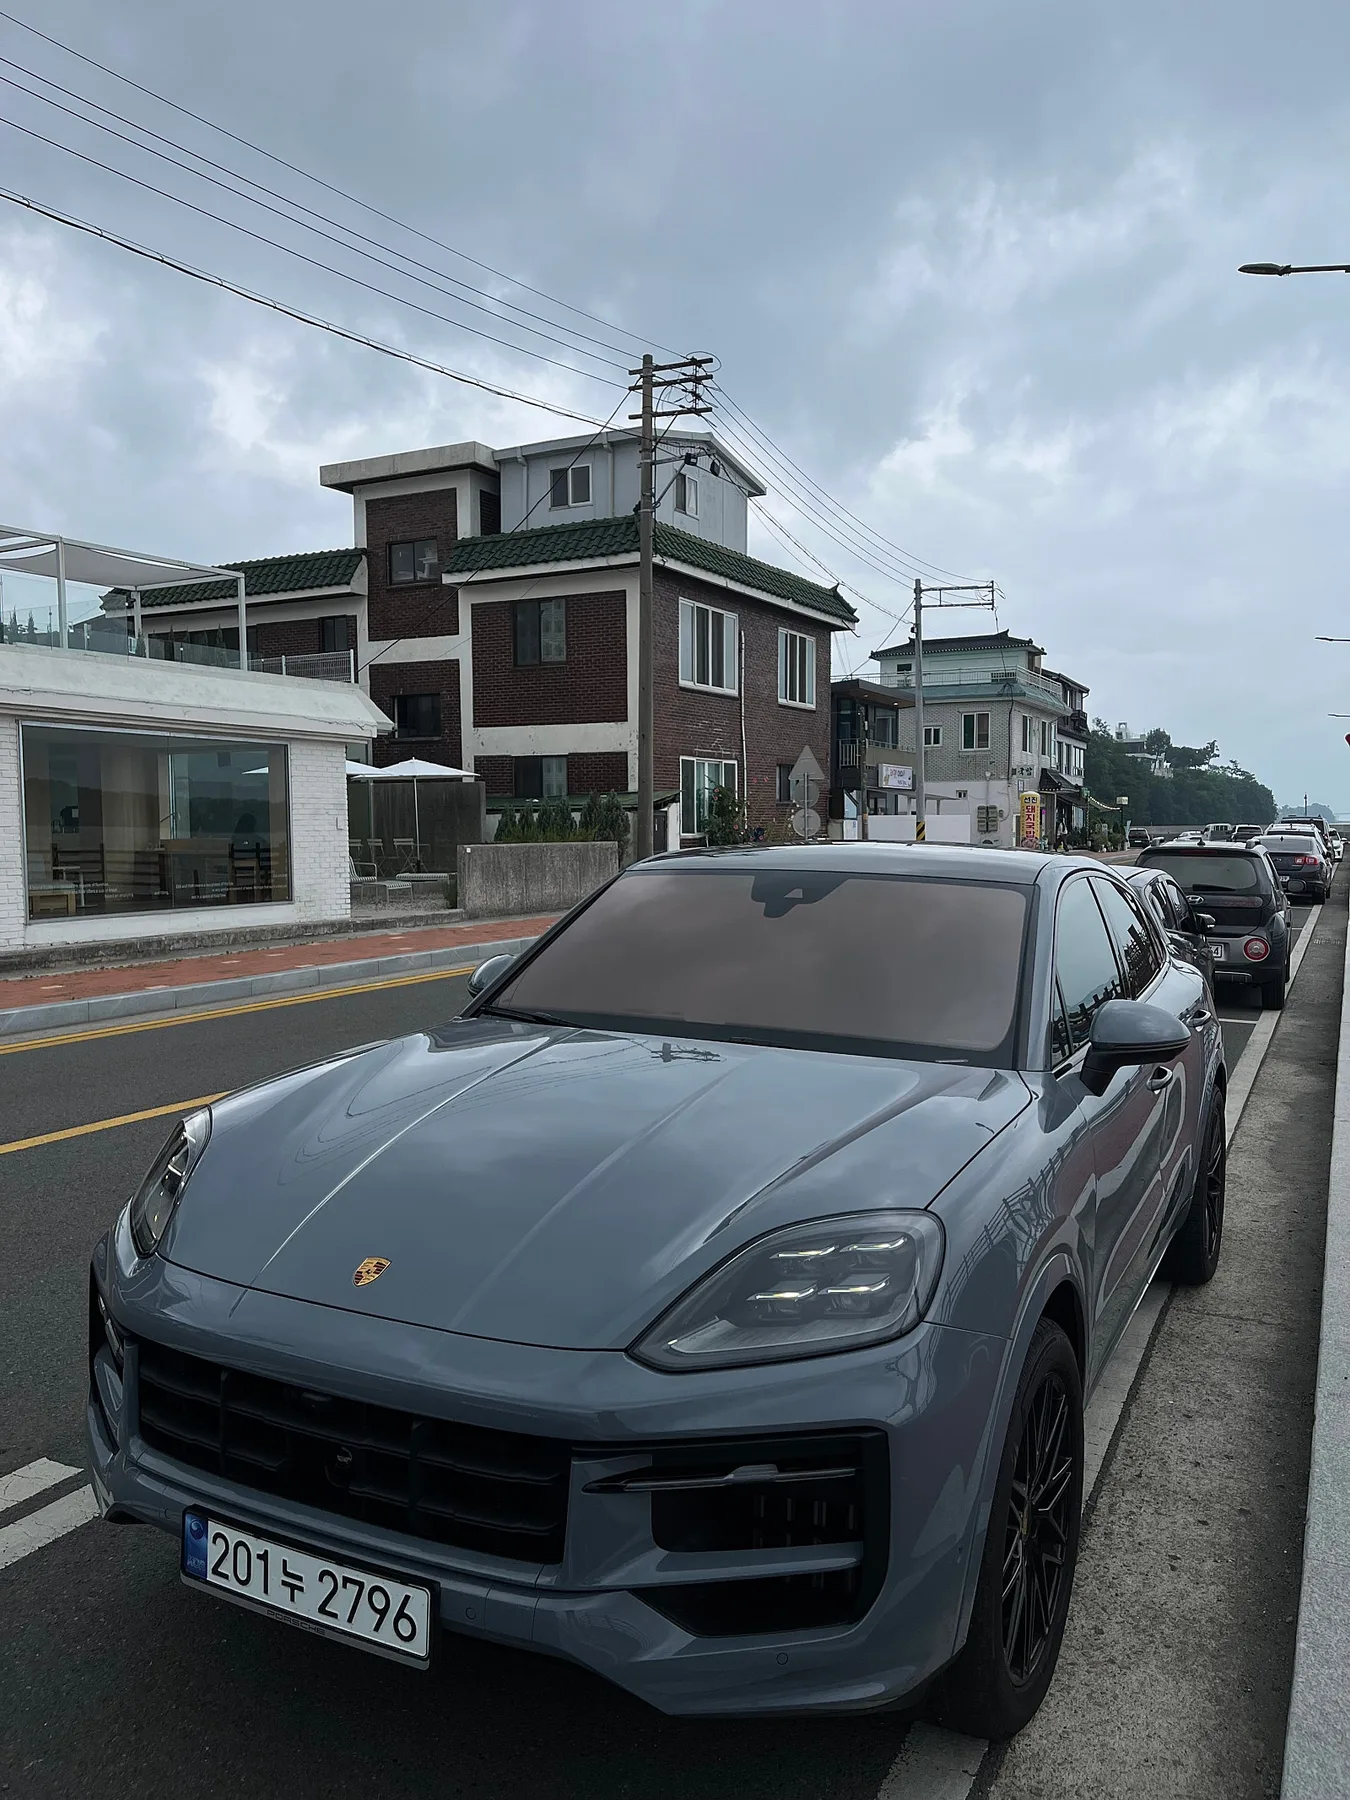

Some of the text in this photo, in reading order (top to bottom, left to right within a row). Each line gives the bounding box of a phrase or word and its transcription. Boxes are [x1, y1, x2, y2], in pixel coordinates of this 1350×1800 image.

[1024, 796, 1038, 804] 선진
[1025, 805, 1036, 839] 돼지국밥
[266, 1609, 327, 1636] PORSCHE
